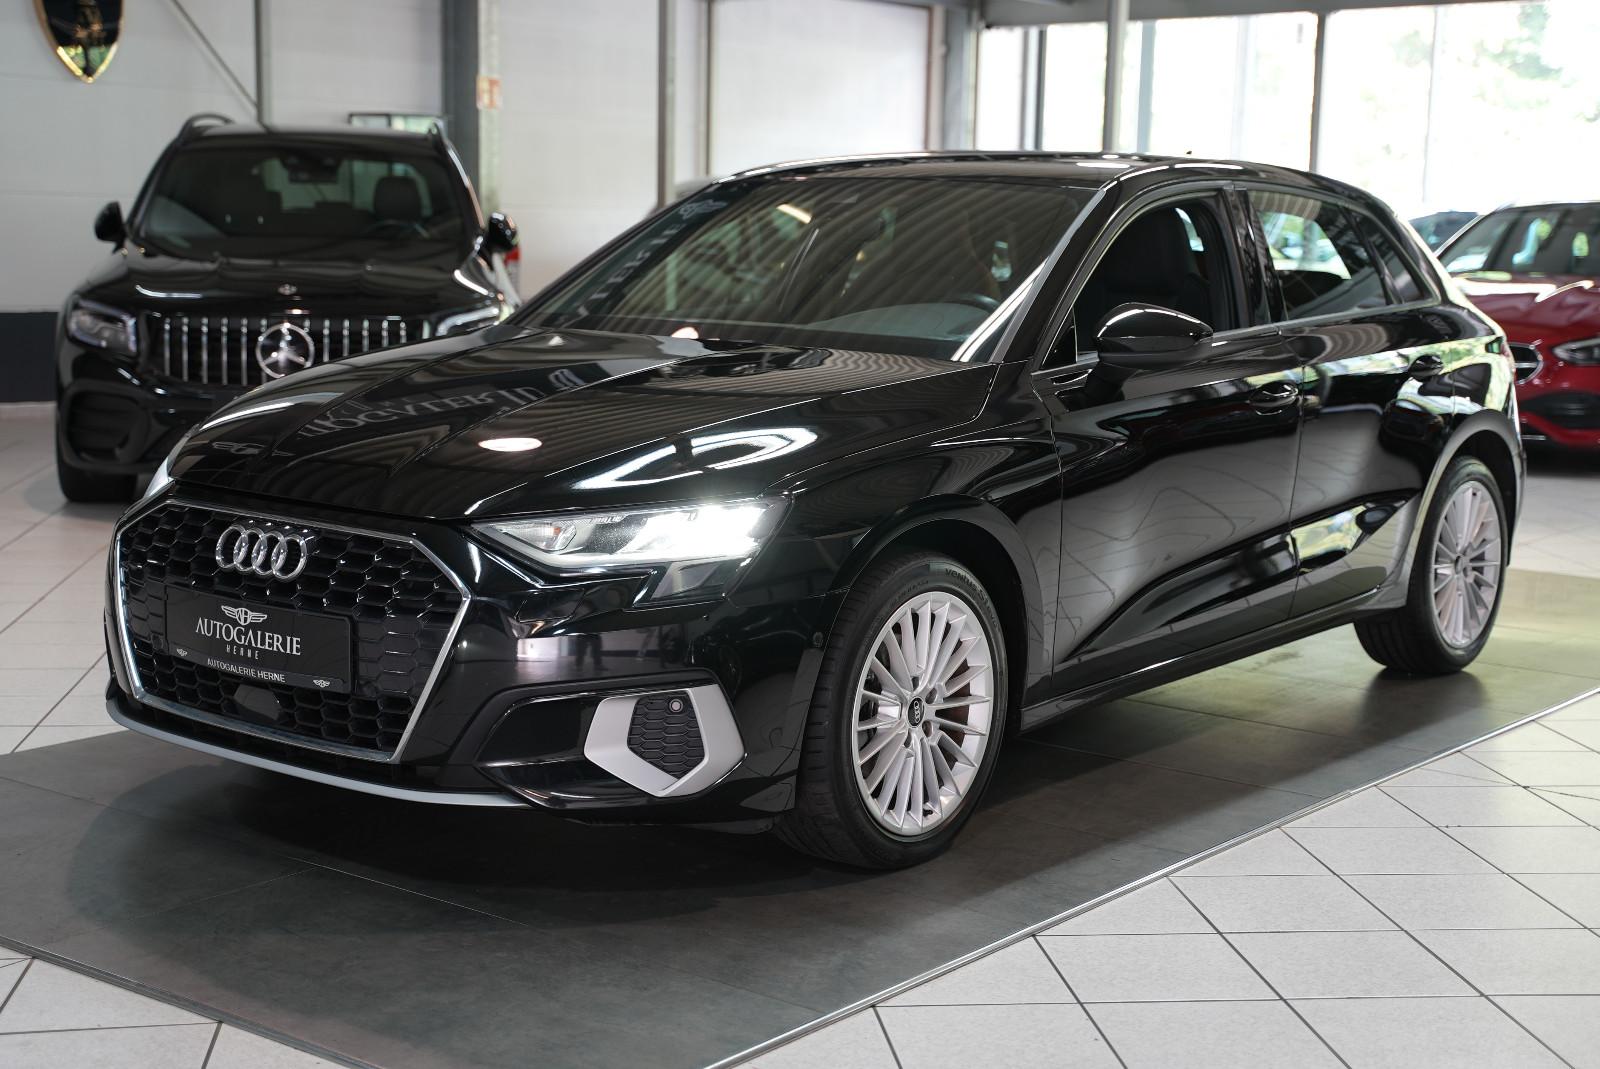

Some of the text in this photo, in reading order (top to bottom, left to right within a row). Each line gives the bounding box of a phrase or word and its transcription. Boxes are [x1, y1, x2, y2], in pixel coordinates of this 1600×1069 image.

[195, 616, 301, 656] AUTOGALERIE
[226, 643, 259, 660] HERNE
[207, 657, 286, 683] AUTOGALERIE HERNE
